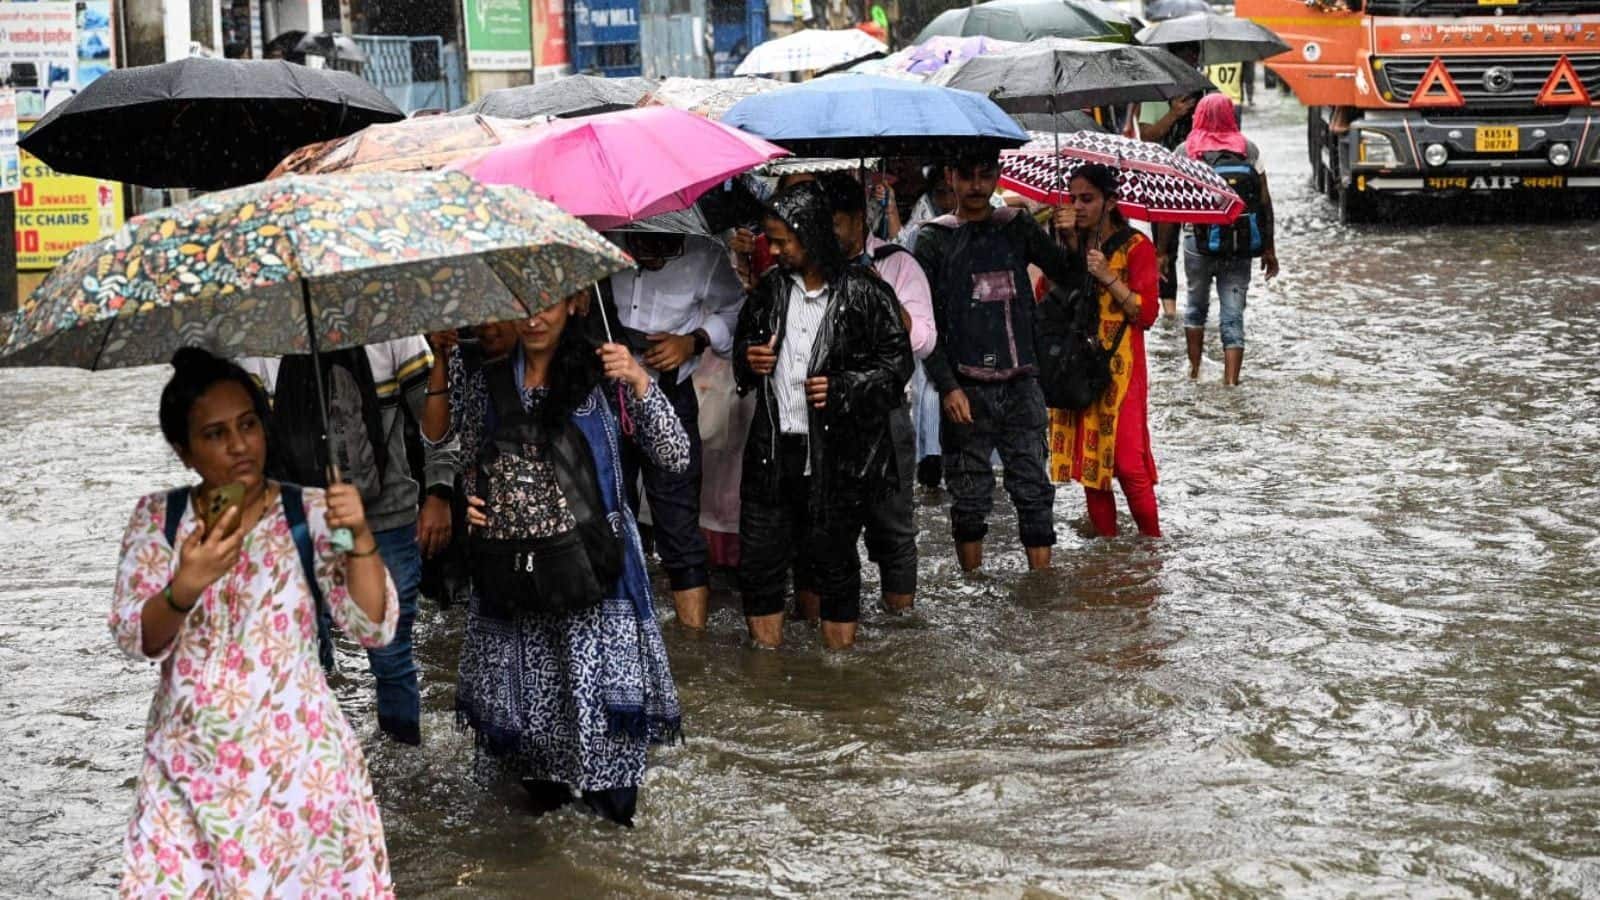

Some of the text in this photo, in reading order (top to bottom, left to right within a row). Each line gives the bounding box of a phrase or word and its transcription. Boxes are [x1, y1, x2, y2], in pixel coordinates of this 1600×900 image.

[610, 8, 637, 25] MILL
[1493, 23, 1528, 32] Travel
[1536, 23, 1561, 33] Vlog
[1218, 66, 1236, 84] 07
[1470, 175, 1520, 189] AIP
[40, 195, 87, 205] ONWARDS
[36, 214, 89, 226] CHAIRS
[45, 241, 88, 251] ONWAR
